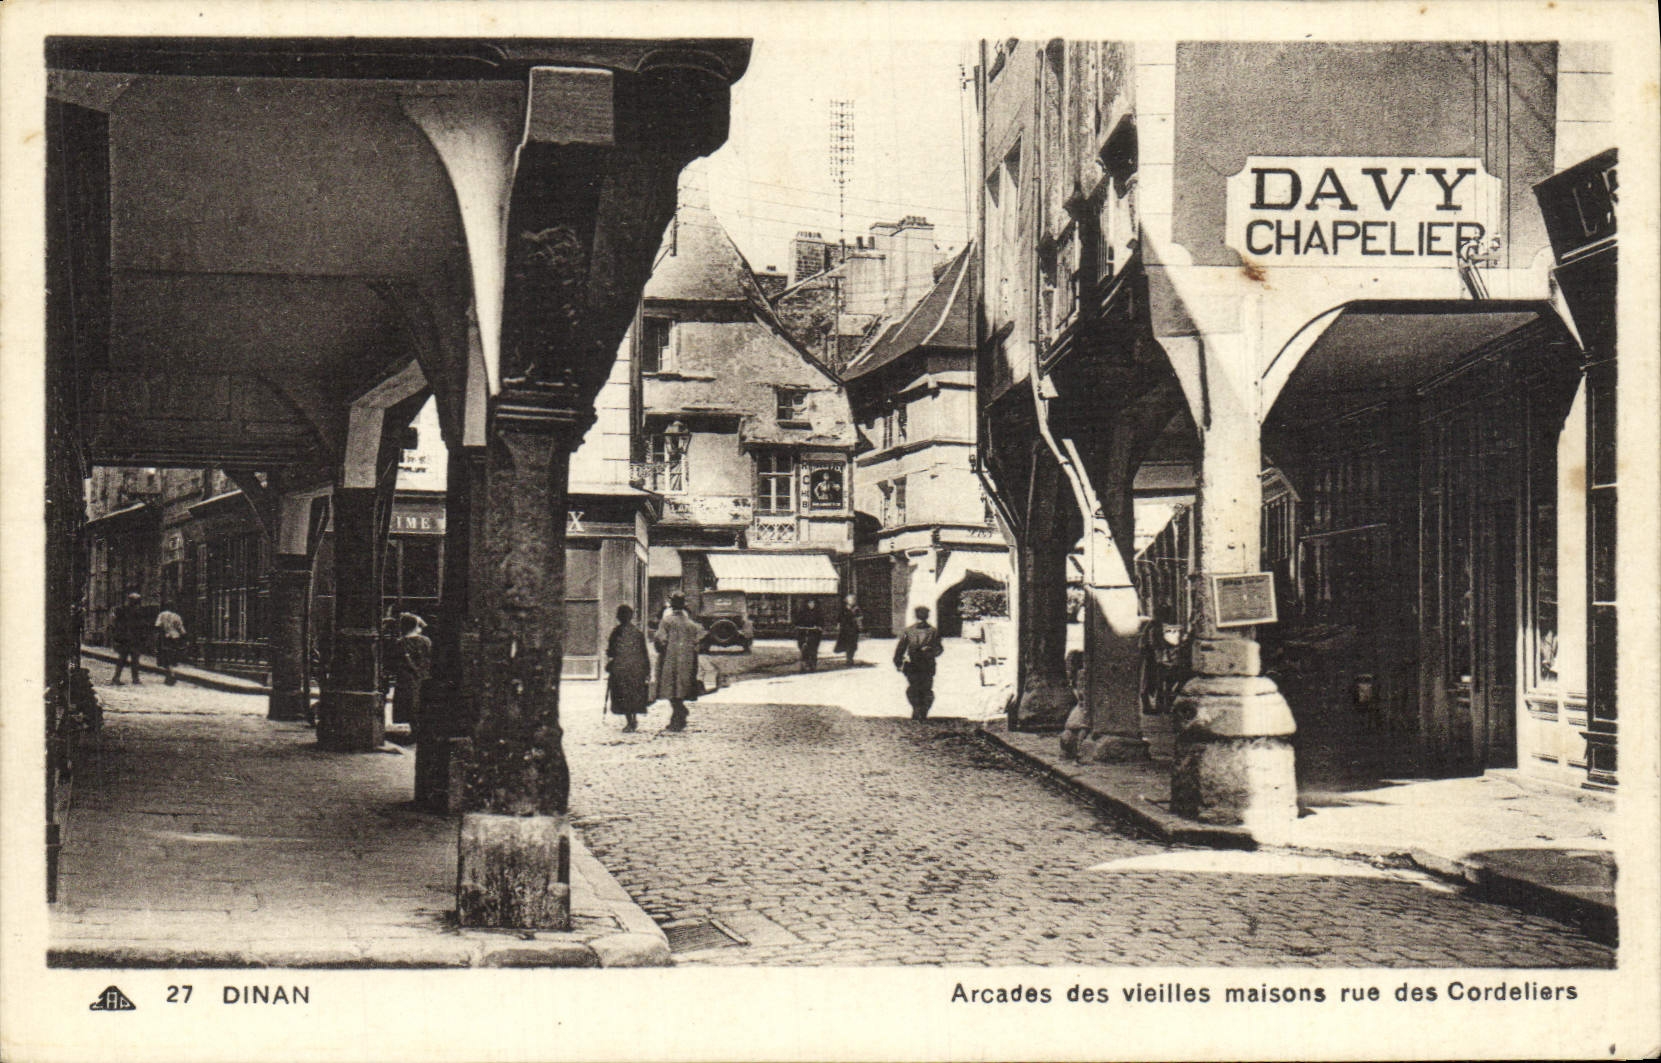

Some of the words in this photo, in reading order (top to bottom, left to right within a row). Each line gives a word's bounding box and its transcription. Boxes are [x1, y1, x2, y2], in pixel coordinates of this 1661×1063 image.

[1250, 167, 1476, 211] DAVY
[1246, 219, 1486, 257] CHAPELIER
[390, 516, 430, 529] IME
